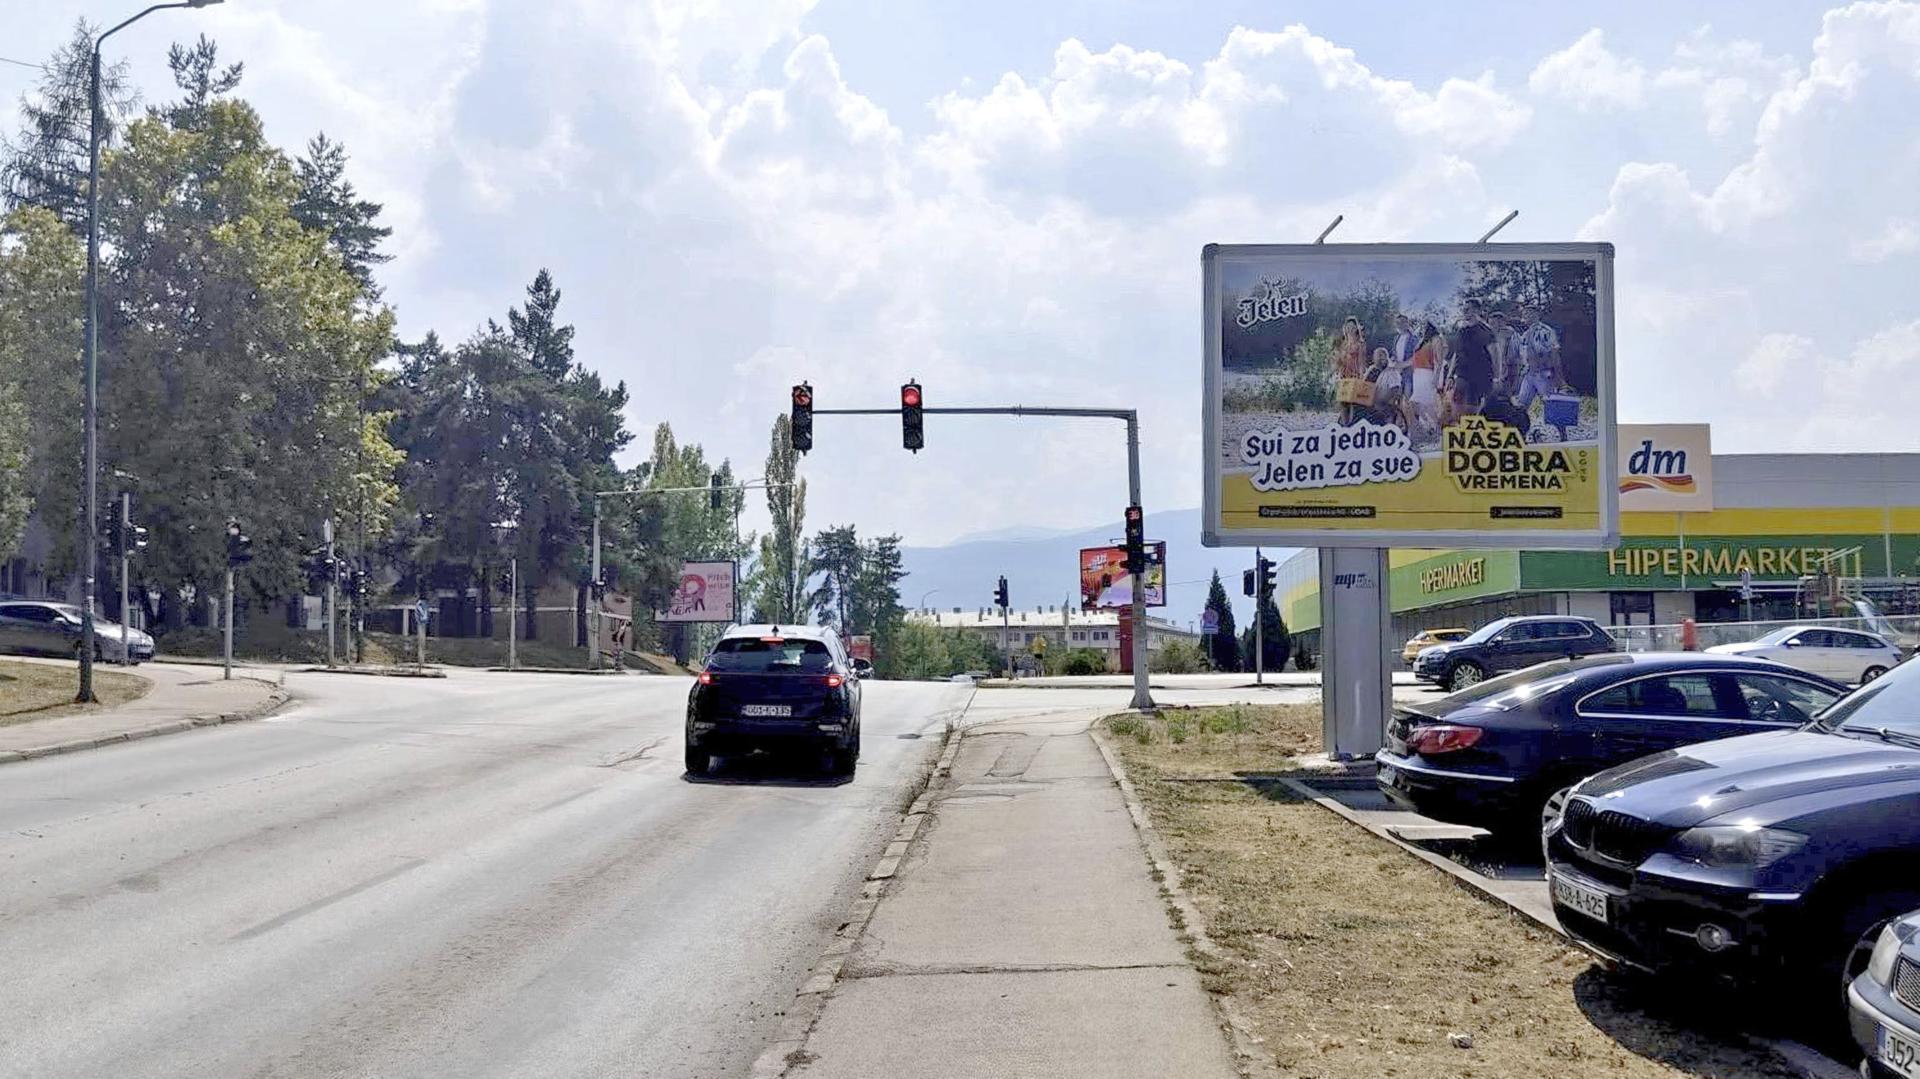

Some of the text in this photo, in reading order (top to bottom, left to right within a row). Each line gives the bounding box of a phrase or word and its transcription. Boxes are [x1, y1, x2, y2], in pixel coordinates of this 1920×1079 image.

[1237, 295, 1307, 327] Jelen
[1466, 419, 1485, 430] ZA
[1292, 436, 1319, 454] za
[1324, 426, 1404, 459] jedno,
[1449, 427, 1522, 449] NAŠA
[1449, 451, 1571, 473] DOBRA
[1628, 440, 1686, 475] dm
[1258, 460, 1324, 484] Jelen
[1334, 460, 1361, 479] za
[1458, 475, 1562, 489] VREMENA
[1608, 548, 1837, 576] HIPERMARKET
[1420, 557, 1485, 594] HIPERMARKET
